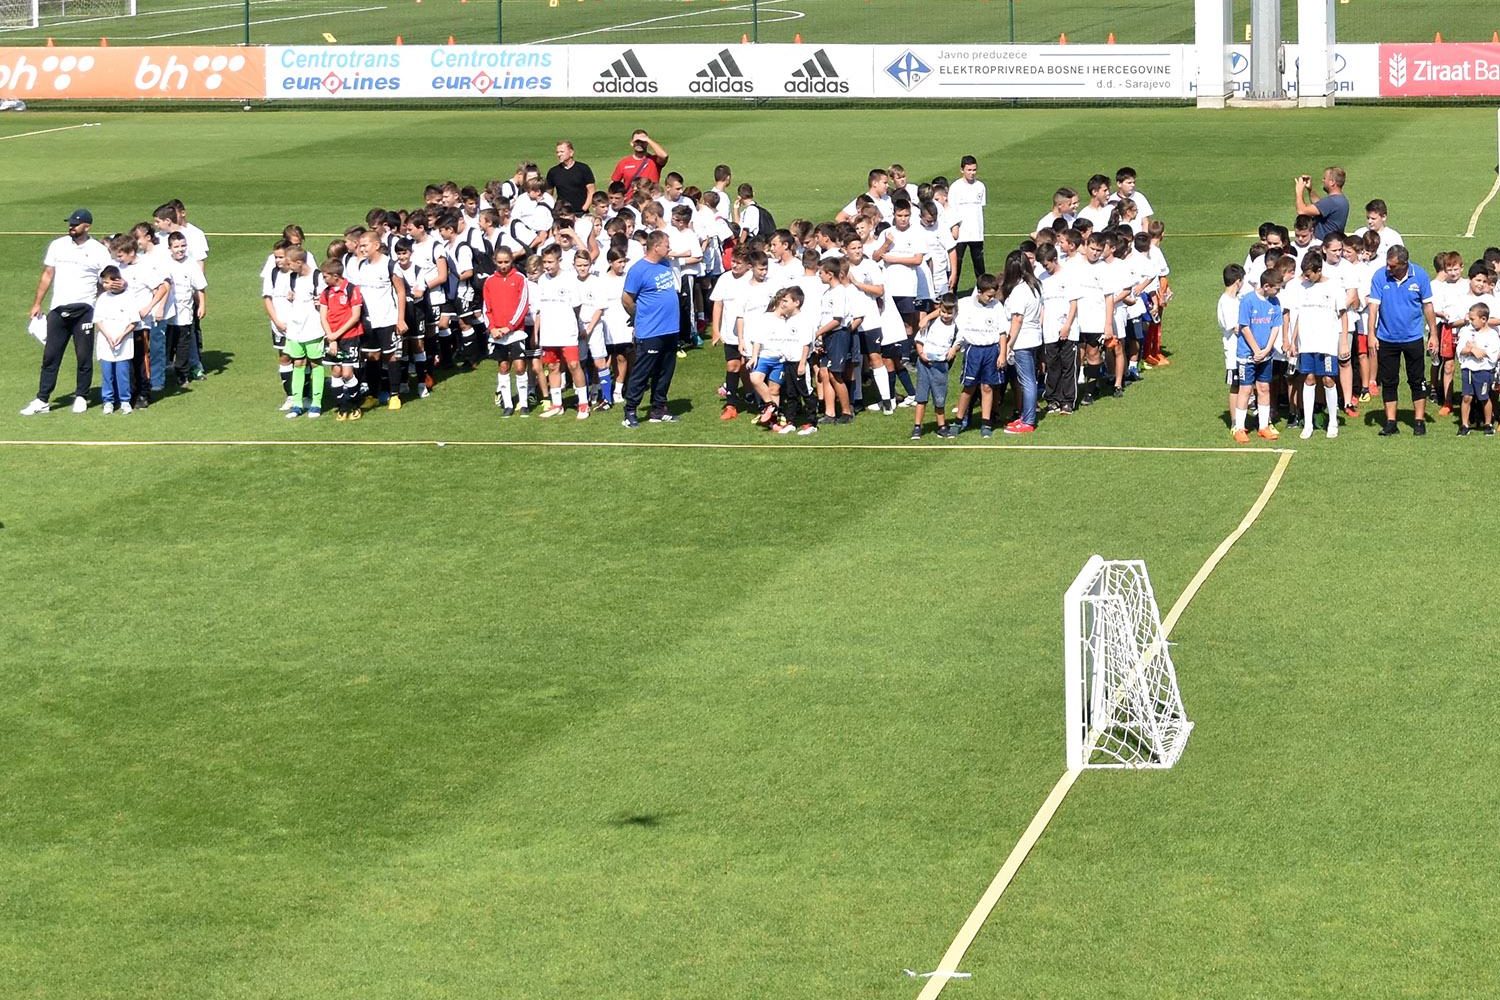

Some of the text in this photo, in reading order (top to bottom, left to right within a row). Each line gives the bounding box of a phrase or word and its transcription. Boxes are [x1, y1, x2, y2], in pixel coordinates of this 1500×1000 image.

[281, 49, 400, 68] Centrotrans
[431, 49, 552, 68] Centrotrans
[938, 50, 969, 60] Javno
[135, 55, 189, 90] bh
[939, 65, 1044, 75] ELEKTROPRIVREDA
[1047, 65, 1084, 75] BOSNE
[1092, 65, 1171, 75] HERCEGOVINE
[1413, 60, 1471, 81] Ziraat
[593, 77, 658, 93] adidas
[688, 77, 754, 93] adidas
[784, 77, 849, 93] adidas
[1096, 80, 1116, 89] d.d.
[1125, 80, 1171, 91] Sarajevo
